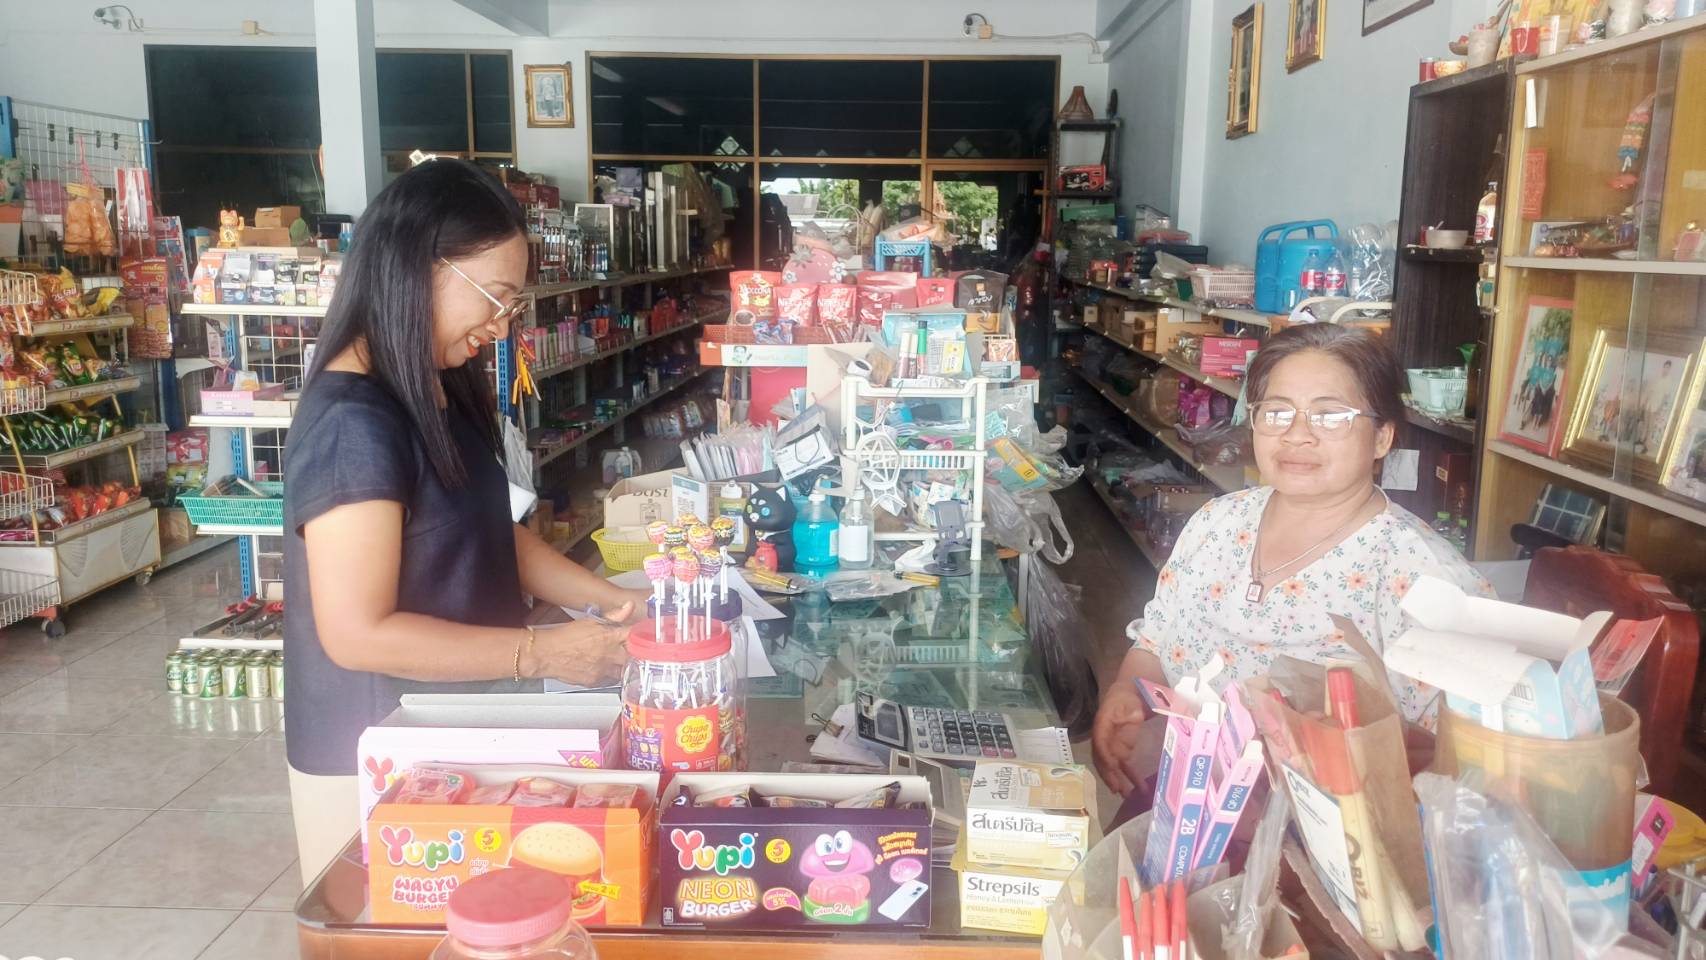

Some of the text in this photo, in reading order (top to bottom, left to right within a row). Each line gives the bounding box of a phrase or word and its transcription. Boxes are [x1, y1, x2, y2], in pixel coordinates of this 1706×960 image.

[1193, 757, 1206, 786] QP-910
[1180, 818, 1197, 836] 2B
[380, 825, 465, 872] Yupi
[671, 828, 756, 876] Yupi
[393, 876, 458, 892] WAGYU
[680, 878, 755, 900] NEON
[967, 876, 1040, 897] Strepsils
[393, 890, 448, 904] BURGE
[680, 899, 755, 919] BURGER
